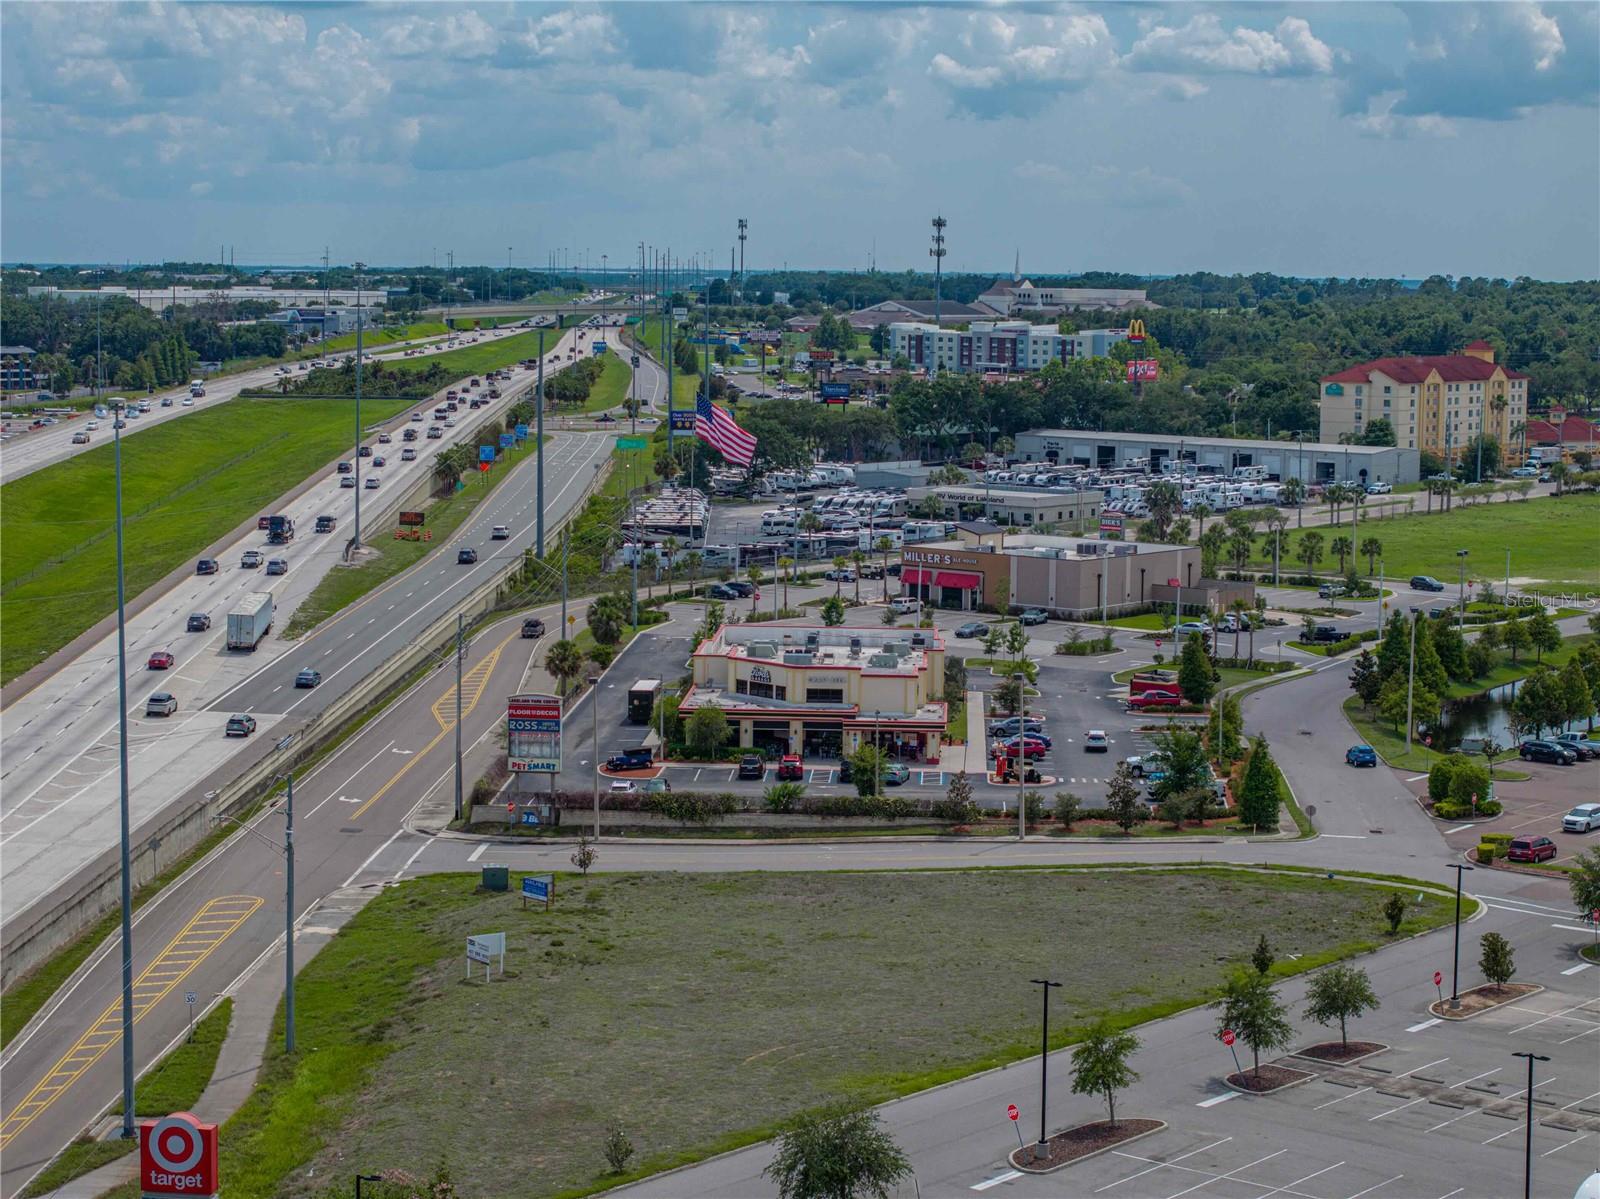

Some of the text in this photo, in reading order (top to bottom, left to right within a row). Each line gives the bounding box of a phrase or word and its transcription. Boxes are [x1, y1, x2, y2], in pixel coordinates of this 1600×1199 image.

[947, 493, 966, 501] World
[903, 551, 951, 565] MILLER'S
[509, 720, 538, 730] ROSS
[150, 1169, 203, 1190] target
